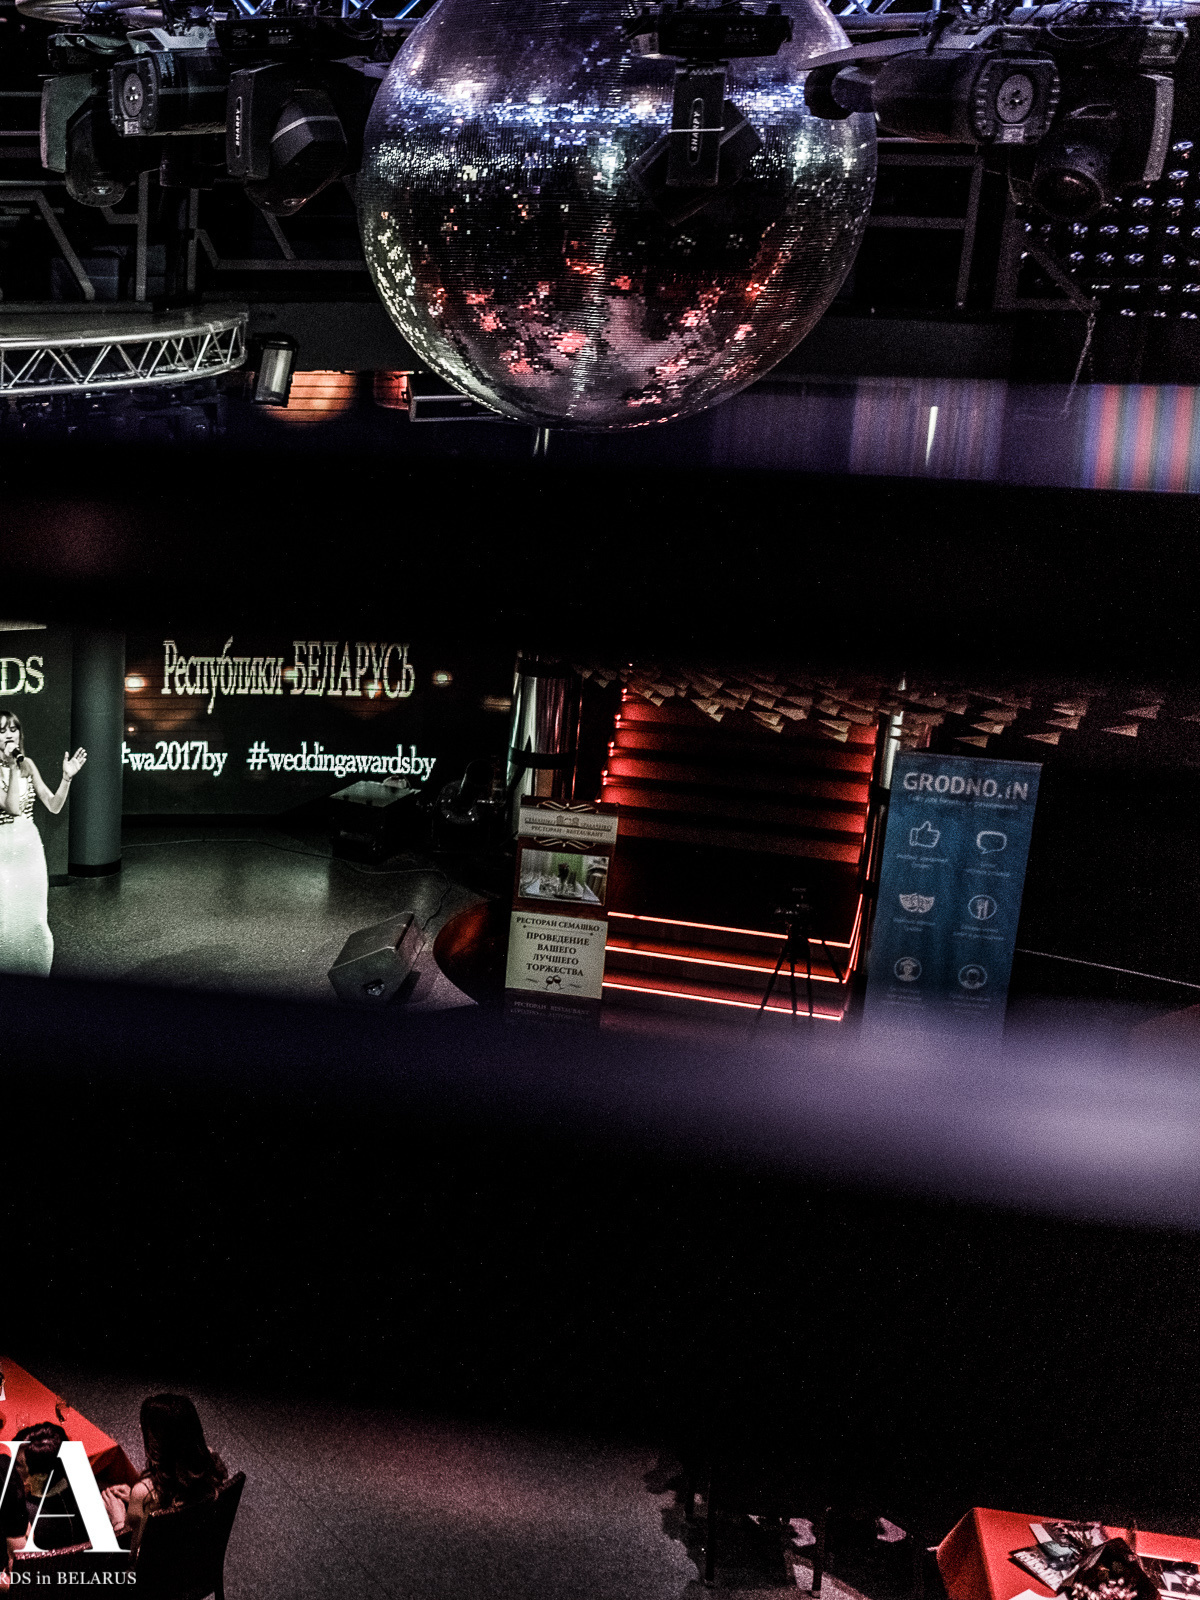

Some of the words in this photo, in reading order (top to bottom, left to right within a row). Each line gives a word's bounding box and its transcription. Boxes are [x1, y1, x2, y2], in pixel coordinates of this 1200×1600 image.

[161, 635, 285, 714] Республики
[289, 640, 416, 699] БЕЛАРУСЬ
[246, 740, 437, 781] #weddingawardsby
[516, 916, 557, 928] РЕСТОРАН
[558, 921, 600, 932] СЕМАШКО
[526, 931, 590, 946] ПРОВЕДЕНИЕ
[537, 943, 577, 955] ВАШЕГО
[532, 953, 579, 966] ЛУЧШЕГО
[526, 963, 584, 977] ТОРЖЕСТВА
